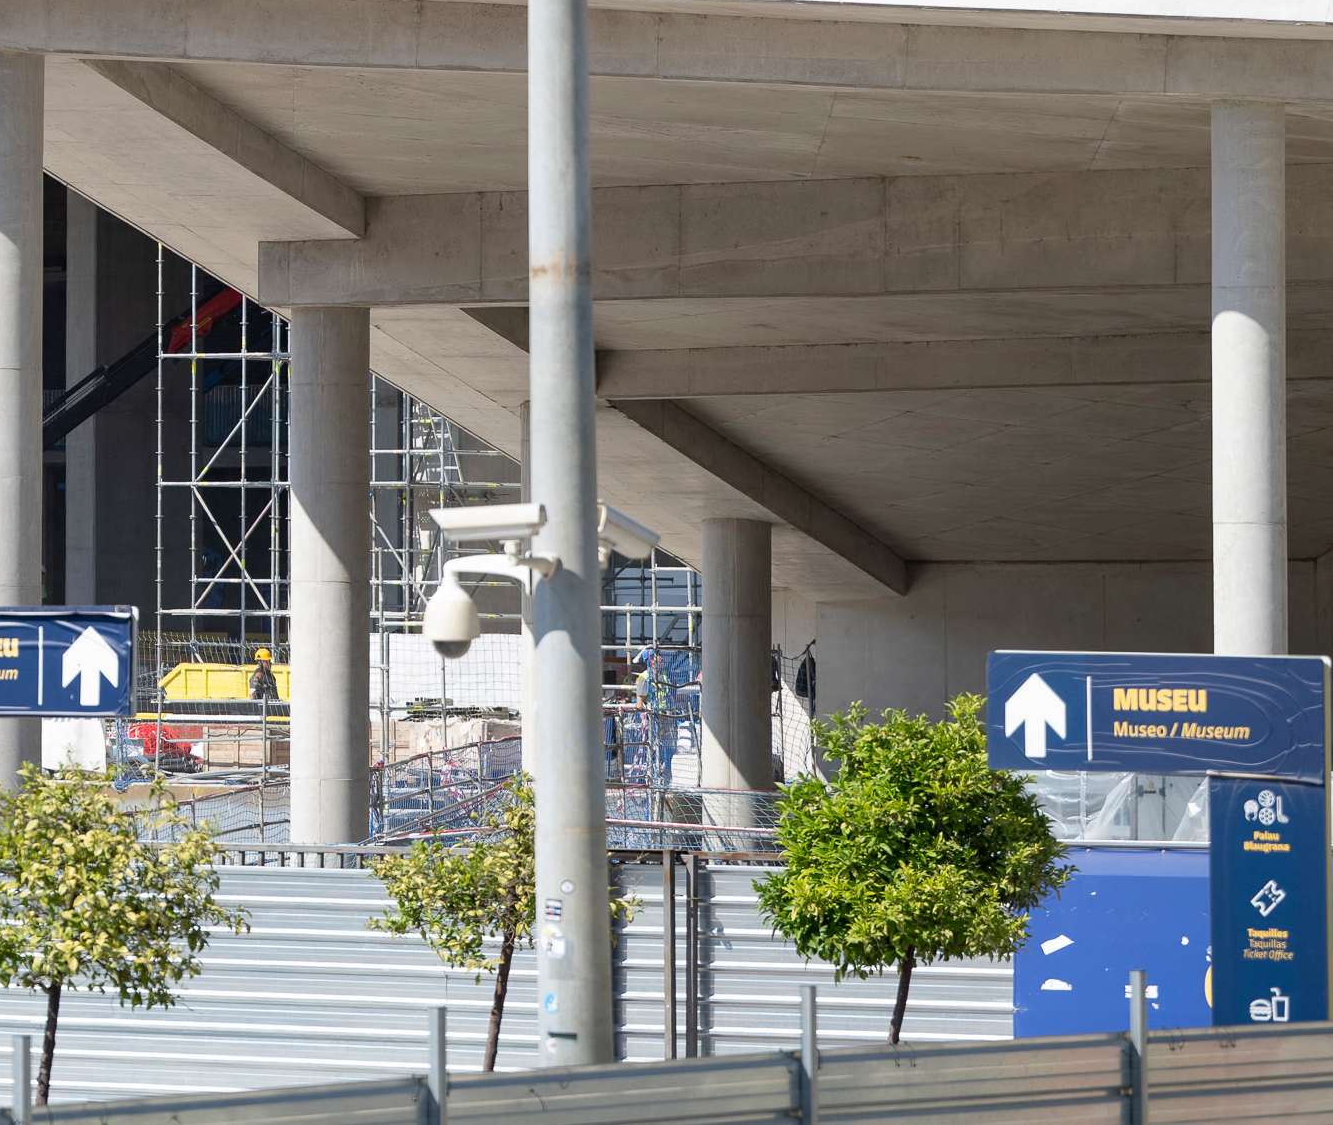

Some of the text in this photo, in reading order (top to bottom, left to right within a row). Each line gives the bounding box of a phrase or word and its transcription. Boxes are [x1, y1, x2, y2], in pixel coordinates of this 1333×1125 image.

[1113, 687, 1207, 713] MUSEU
[1113, 721, 1251, 740] Museo / Museum
[1253, 830, 1281, 842] Palau
[1246, 927, 1290, 940] Taquilles
[1248, 938, 1287, 950] Taquillas
[1242, 948, 1295, 962] Ticket Office
